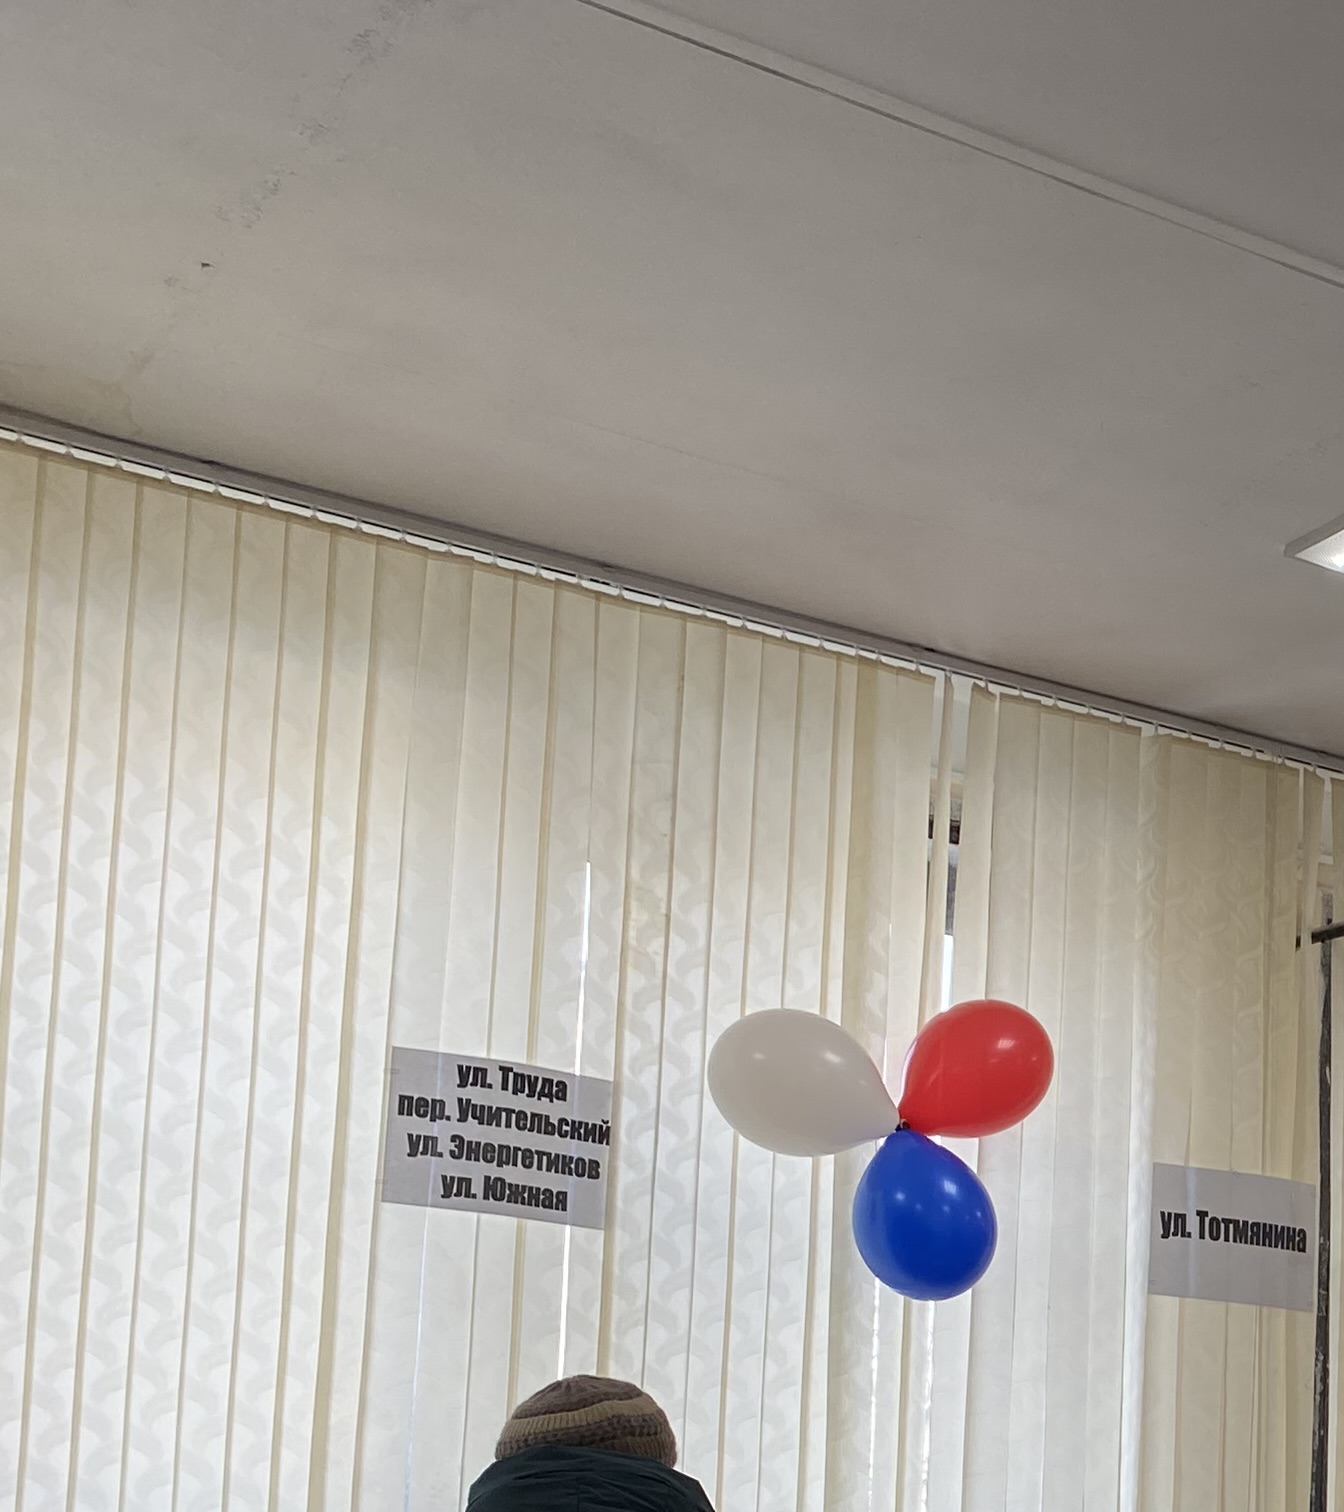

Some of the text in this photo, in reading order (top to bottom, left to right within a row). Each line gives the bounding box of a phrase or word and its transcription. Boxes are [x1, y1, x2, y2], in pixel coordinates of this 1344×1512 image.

[456, 1063, 568, 1104] ул. Труда
[397, 1094, 612, 1147] пер. Учительский
[407, 1132, 602, 1181] ул. Энергетиков
[440, 1174, 568, 1212] ул. Южная
[1159, 1209, 1308, 1254] ул. Тотмянина
